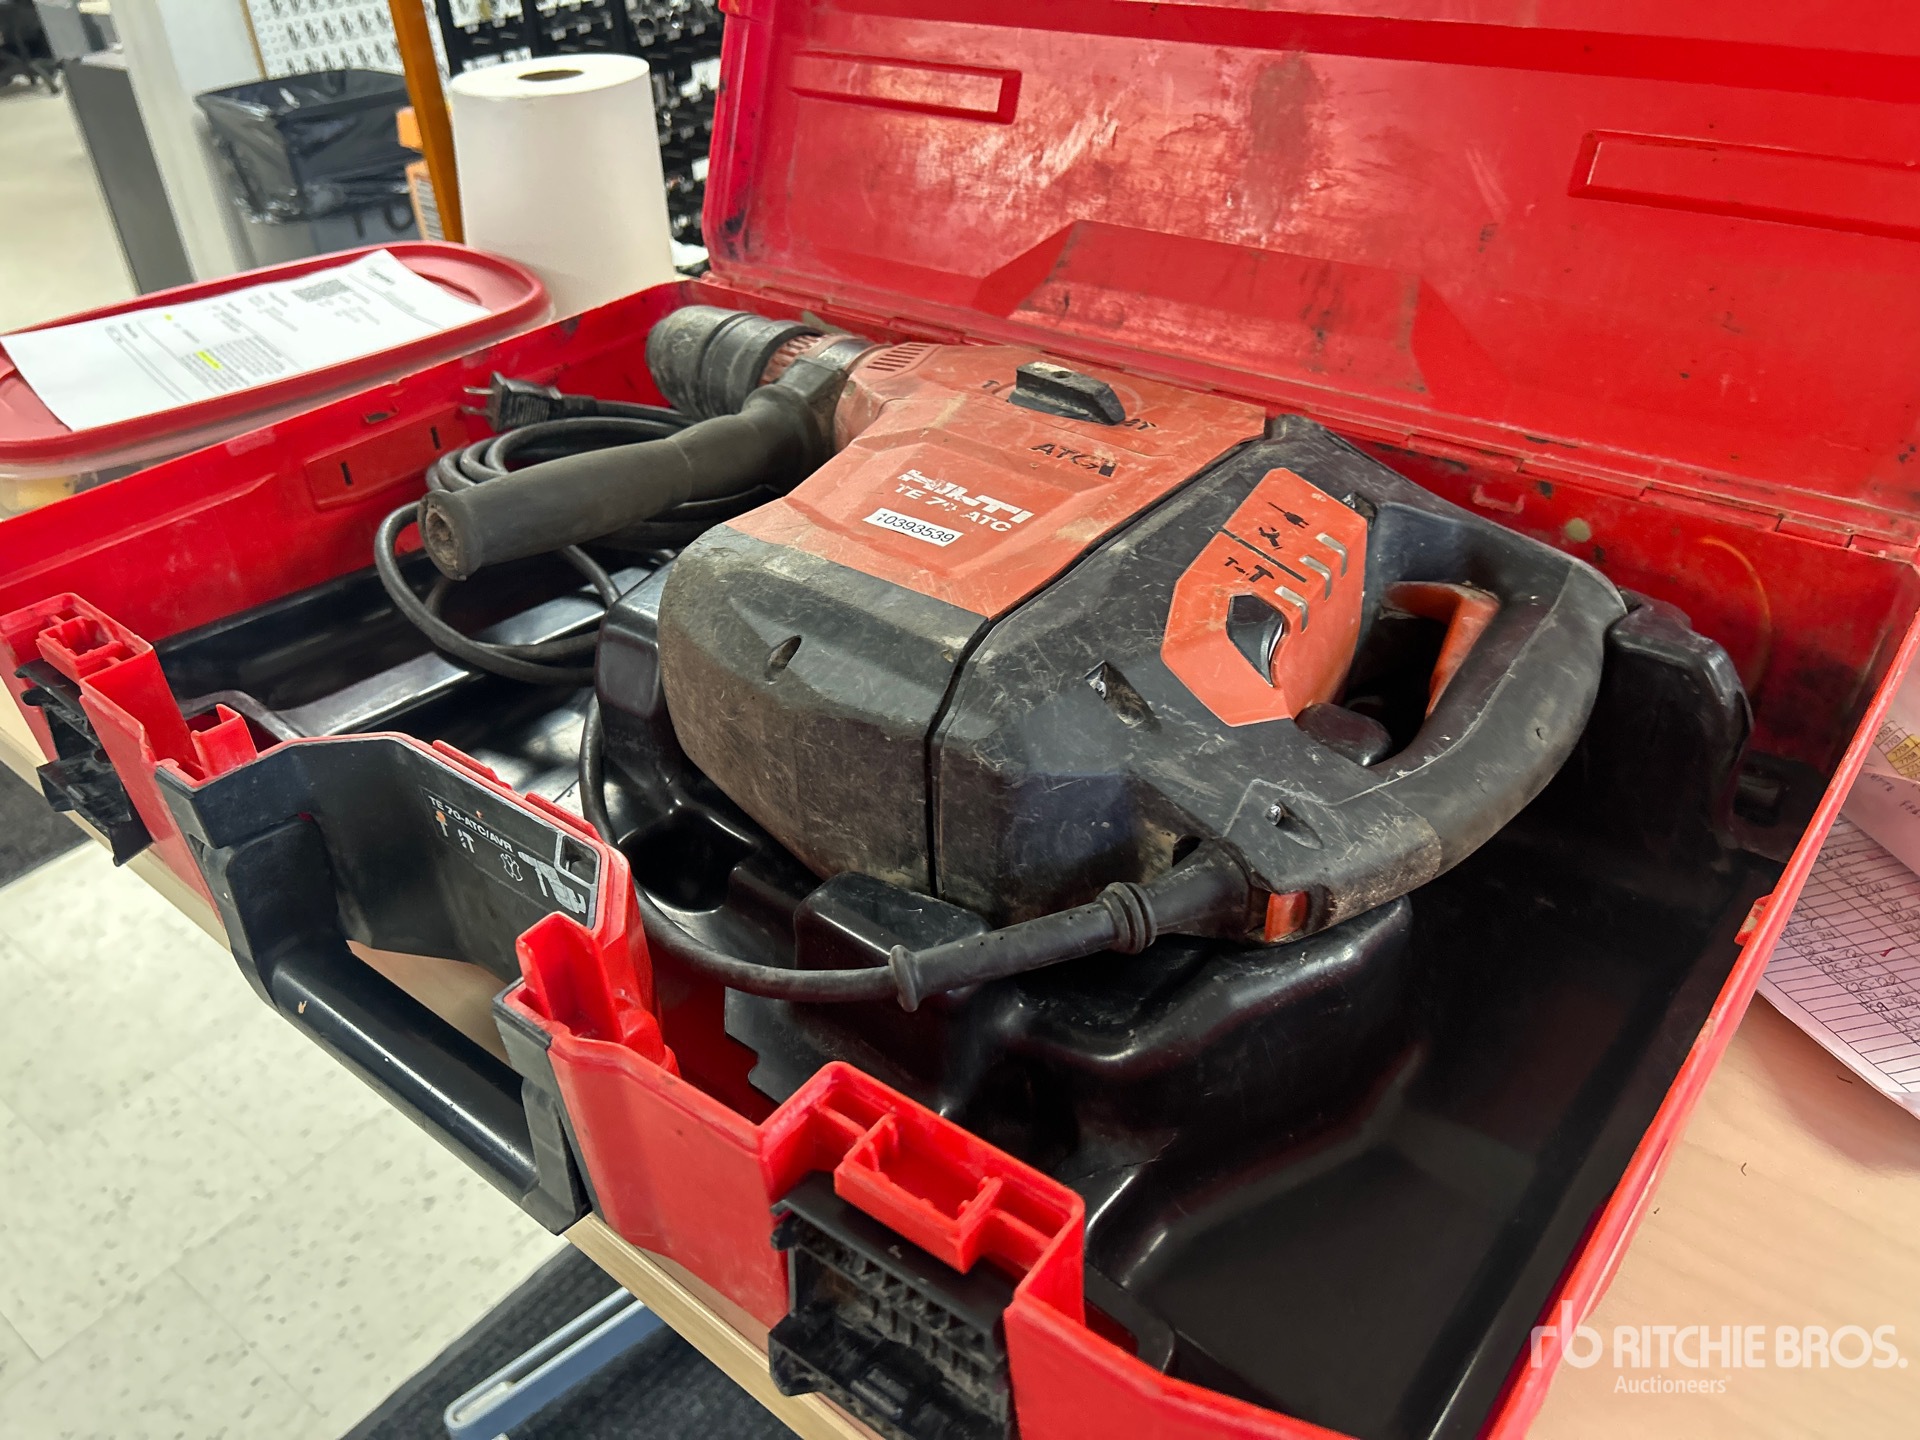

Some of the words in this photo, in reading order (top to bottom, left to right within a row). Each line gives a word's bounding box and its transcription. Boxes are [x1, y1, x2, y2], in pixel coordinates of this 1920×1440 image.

[895, 483, 927, 500] TE
[876, 512, 955, 543] 10393539
[428, 795, 445, 811] TE
[446, 806, 514, 853] 70-ATC/AVR
